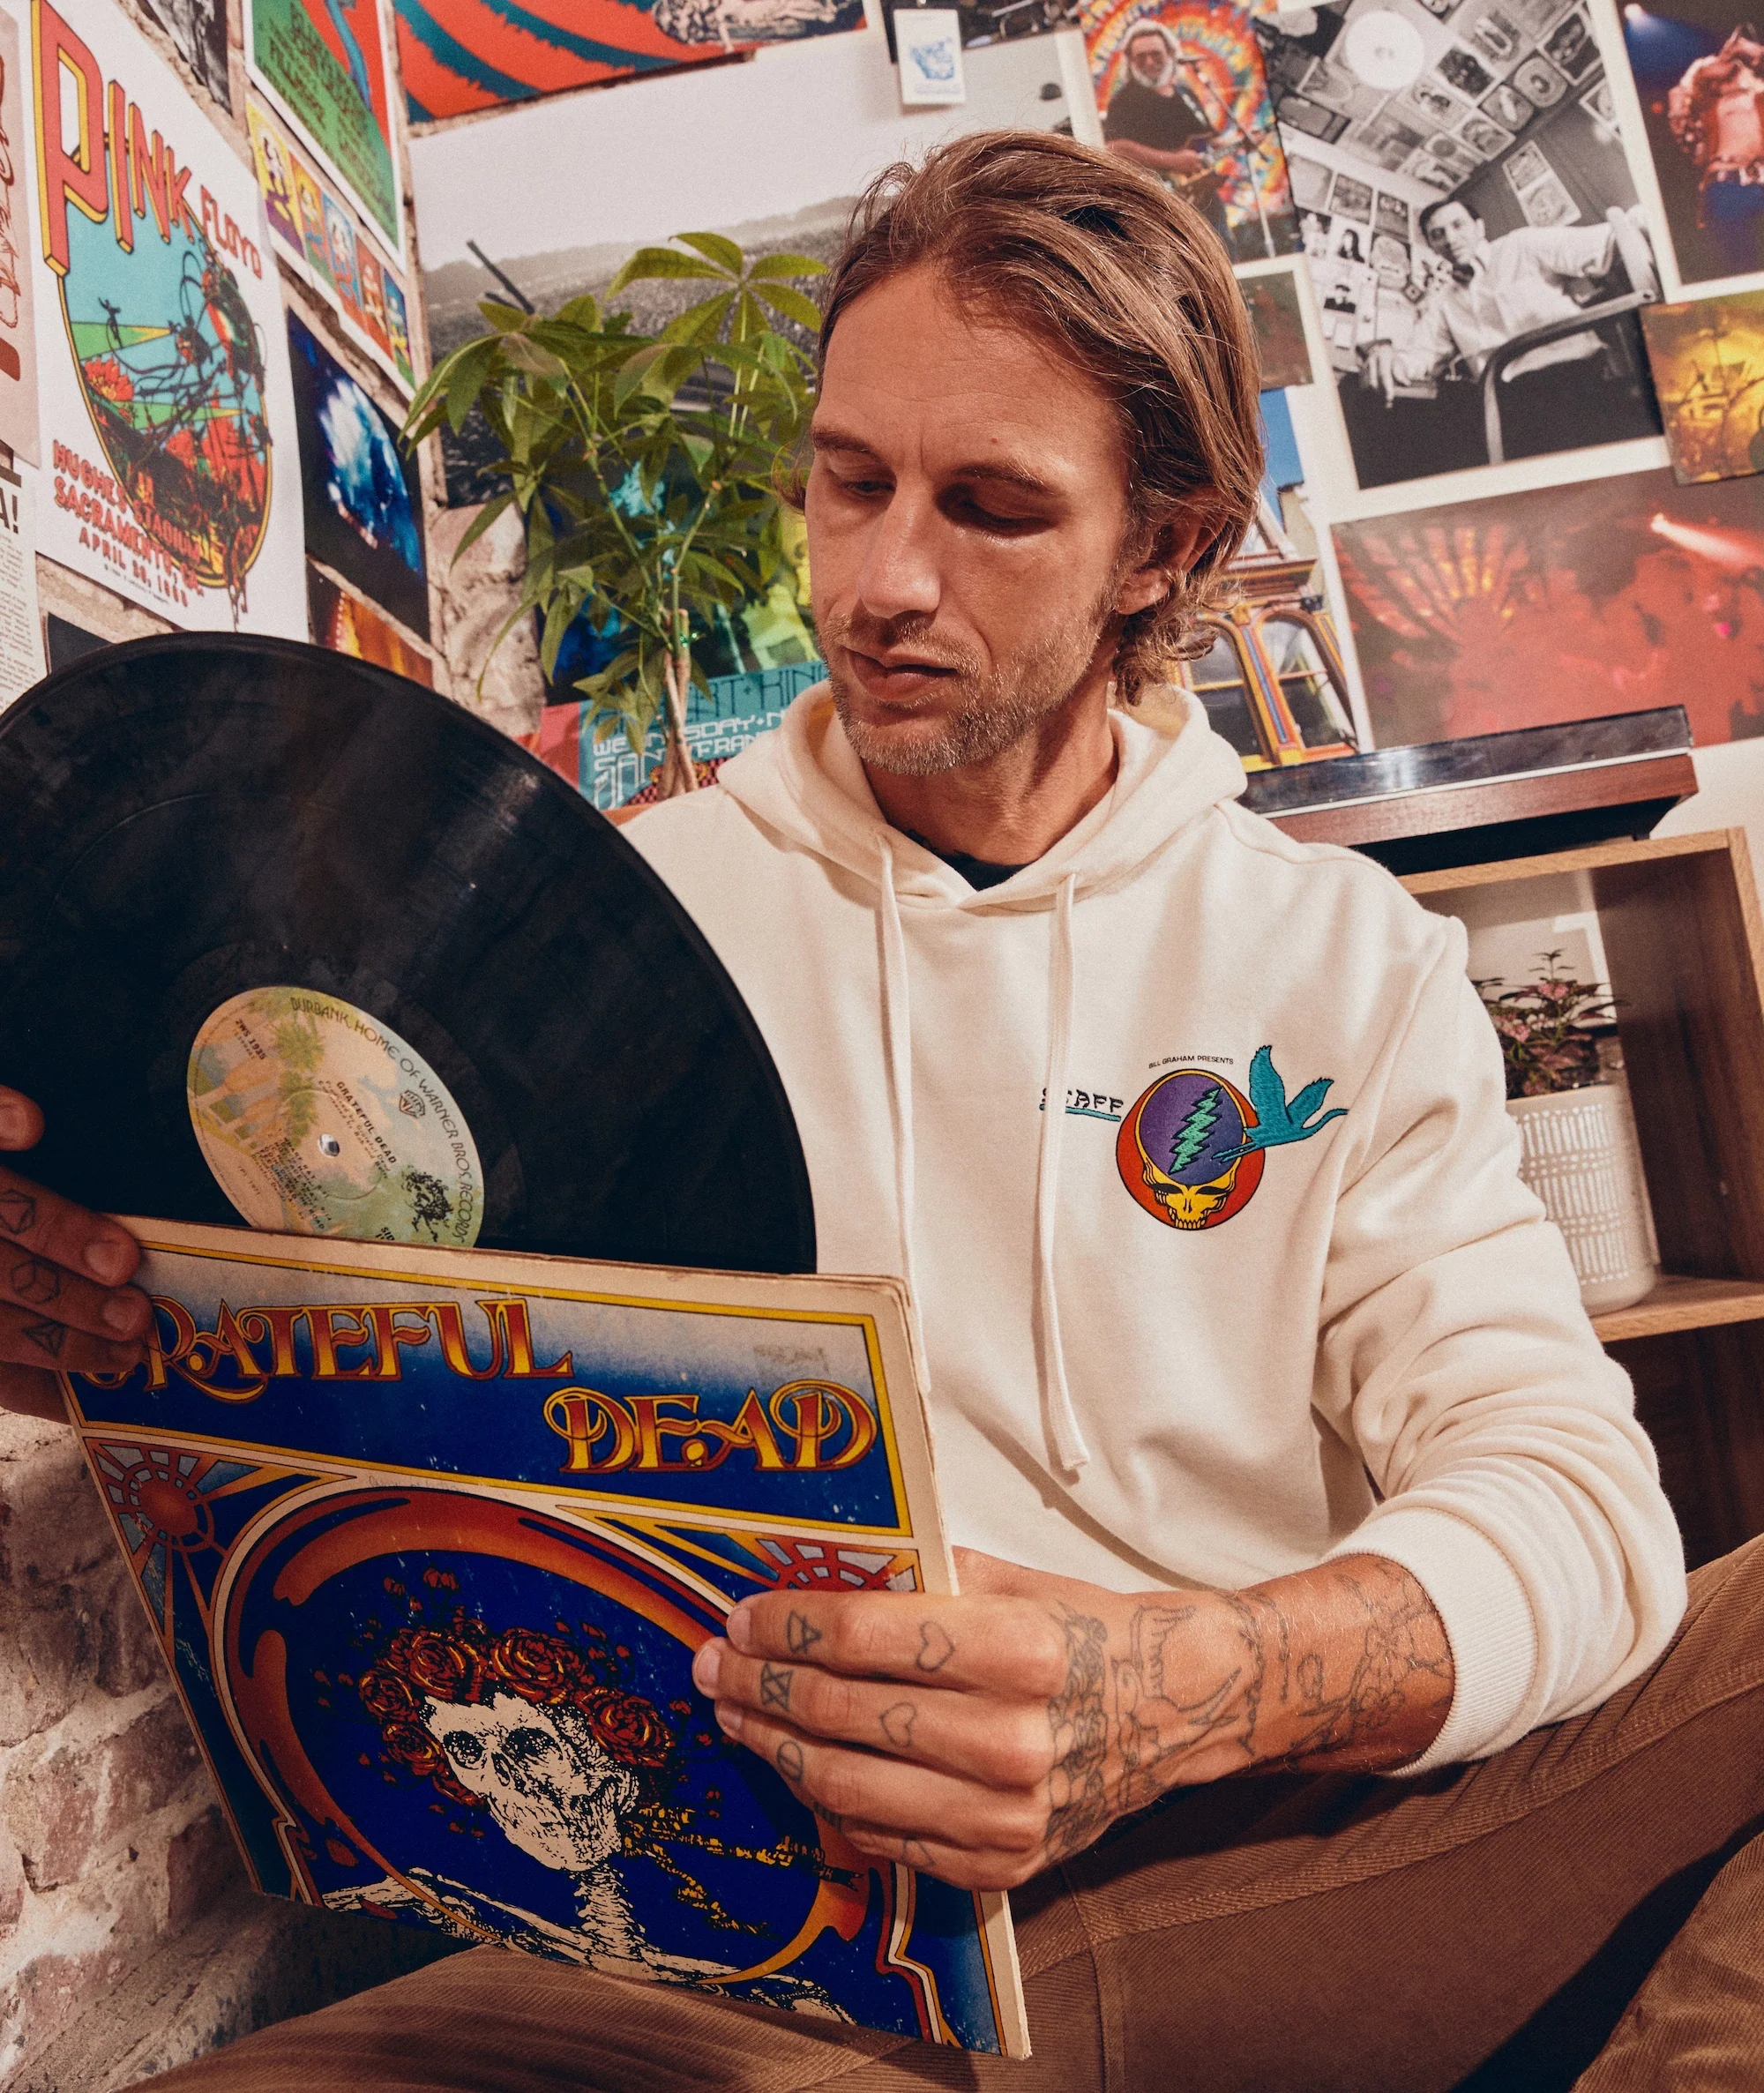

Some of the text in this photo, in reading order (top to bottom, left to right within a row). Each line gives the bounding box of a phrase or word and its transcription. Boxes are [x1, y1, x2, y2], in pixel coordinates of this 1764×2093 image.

[30, 0, 192, 277] PINK
[201, 184, 262, 280] FLOYD
[53, 438, 201, 564] HUGHES STADIUM
[79, 527, 126, 571] APRIL
[1042, 1087, 1124, 1112] AFF
[1148, 1055, 1234, 1069] BILL GRAHAM PRESENTS
[336, 1081, 397, 1164] GRATEFUL DEAD
[355, 1020, 399, 1060] HOME
[399, 1058, 422, 1078] OF
[418, 1077, 459, 1139] WARNER
[452, 1182, 474, 1244] RECORDS
[542, 1379, 877, 1474] DEAD
